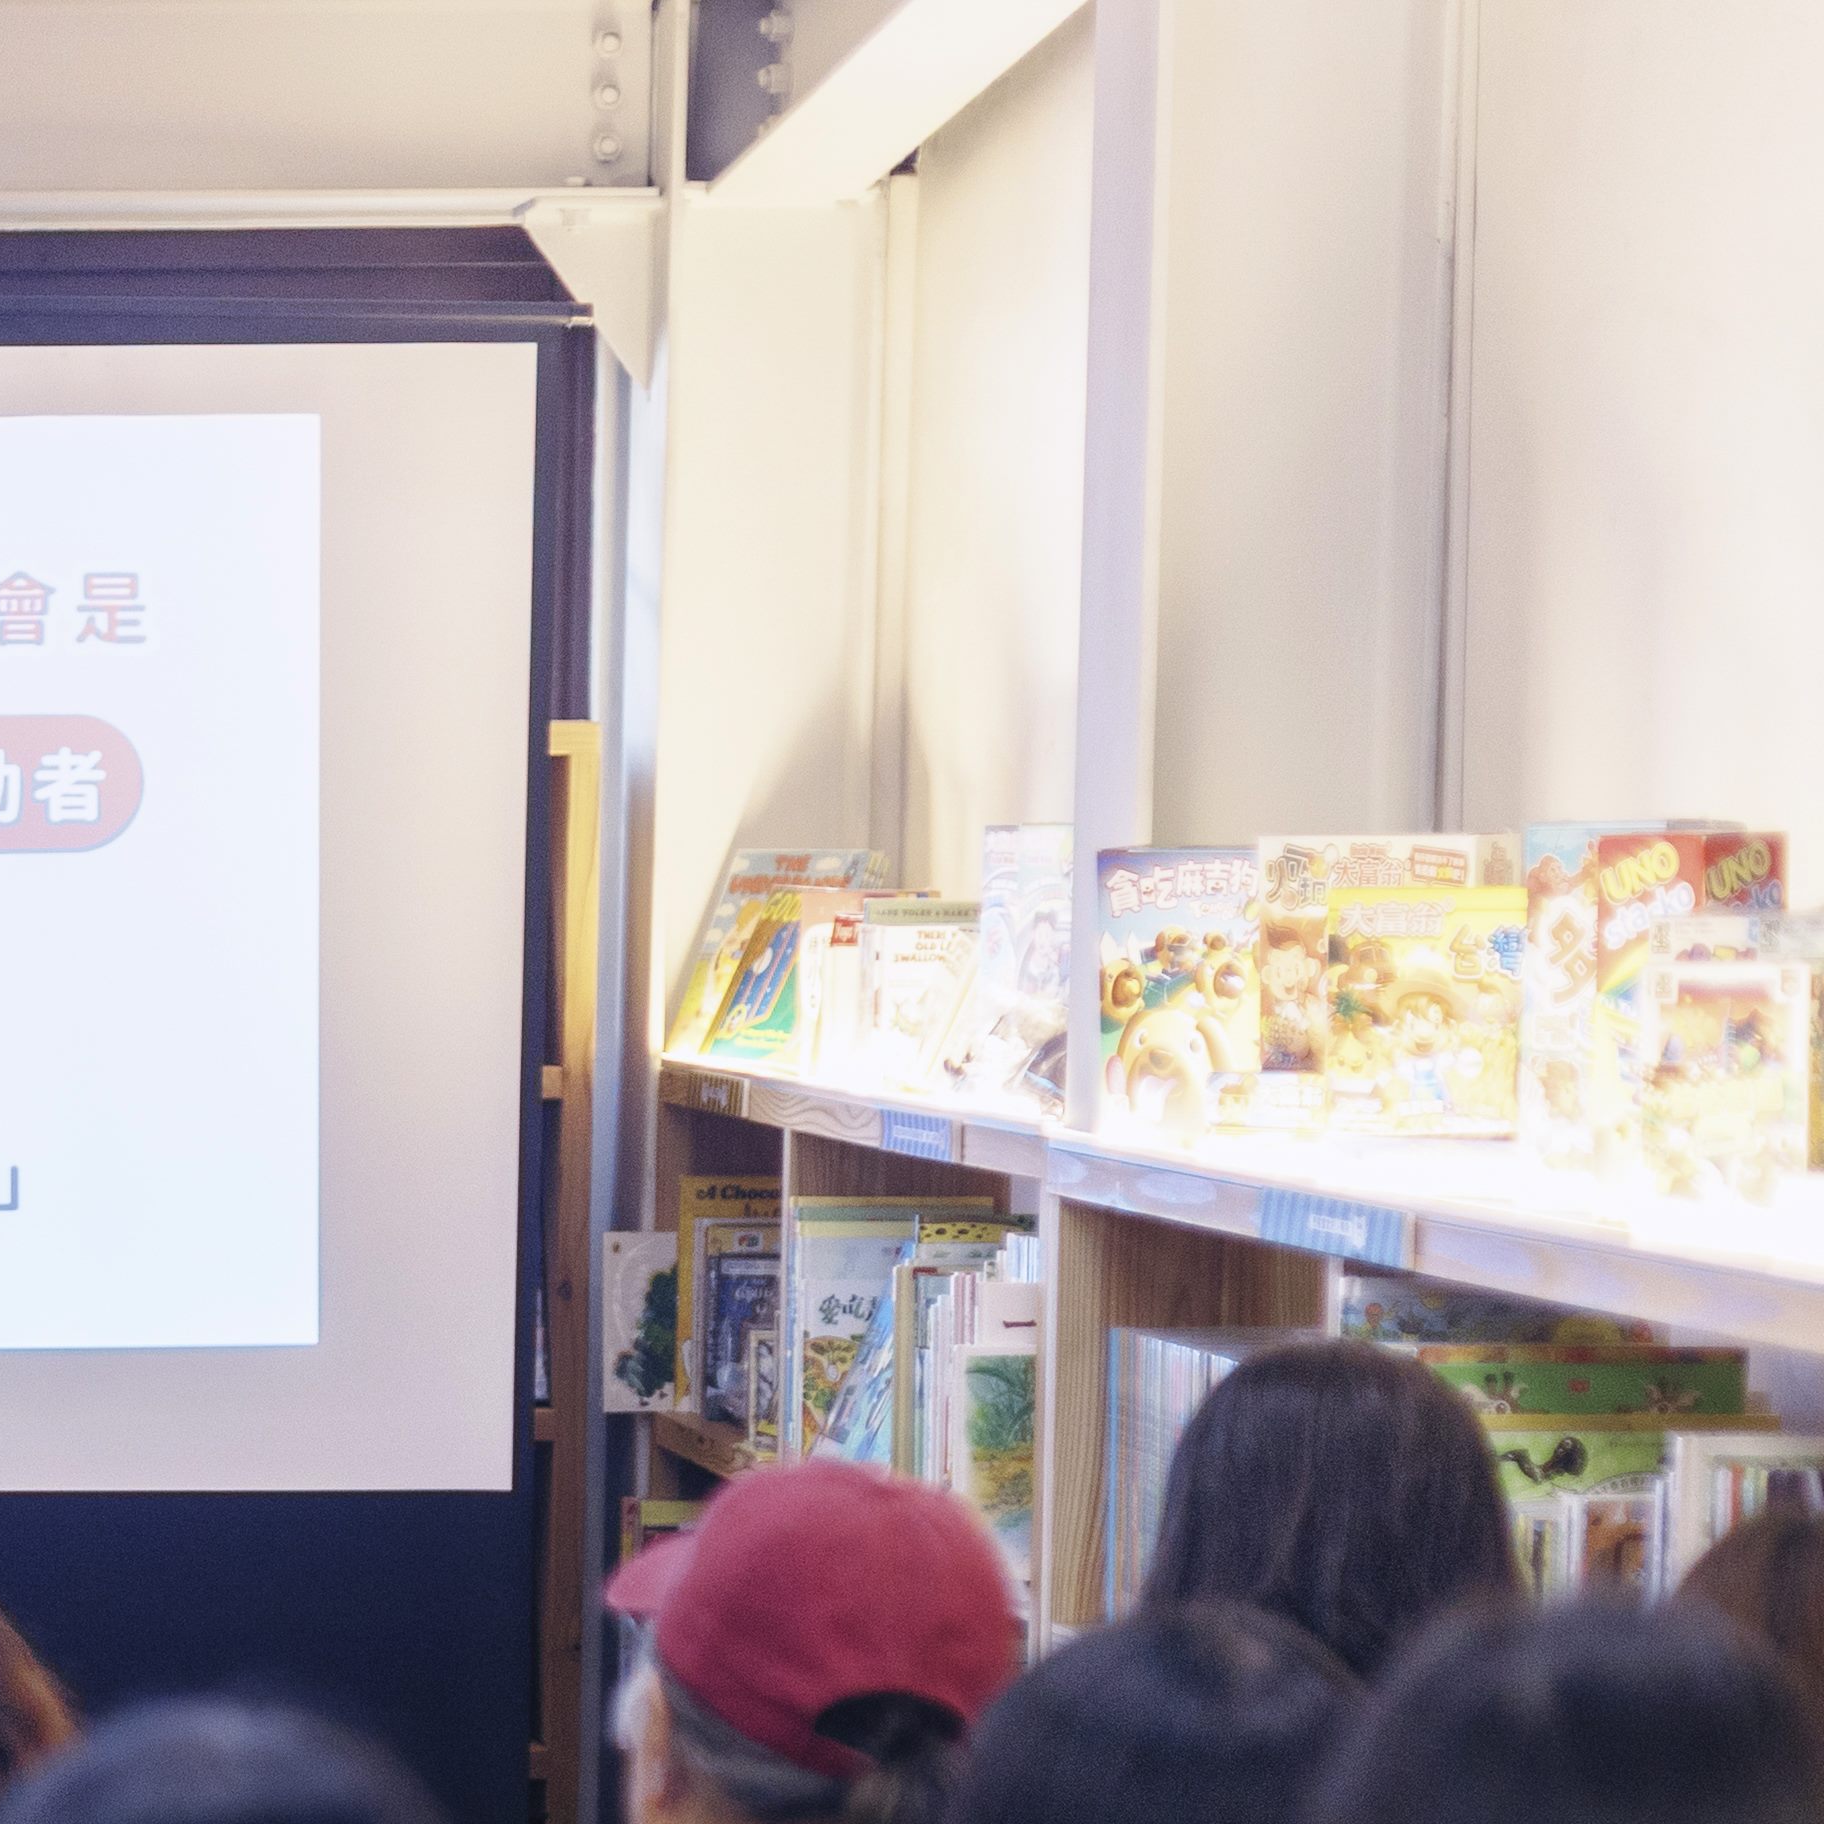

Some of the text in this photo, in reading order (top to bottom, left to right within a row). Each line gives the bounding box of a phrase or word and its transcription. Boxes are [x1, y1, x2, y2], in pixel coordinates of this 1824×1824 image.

[1105, 857, 1258, 917] 貪吃麻吉狗
[1600, 840, 1680, 905] UNO
[1705, 839, 1773, 901] UNO
[1339, 901, 1446, 939] 大富翁
[1449, 924, 1529, 983] 台灣
